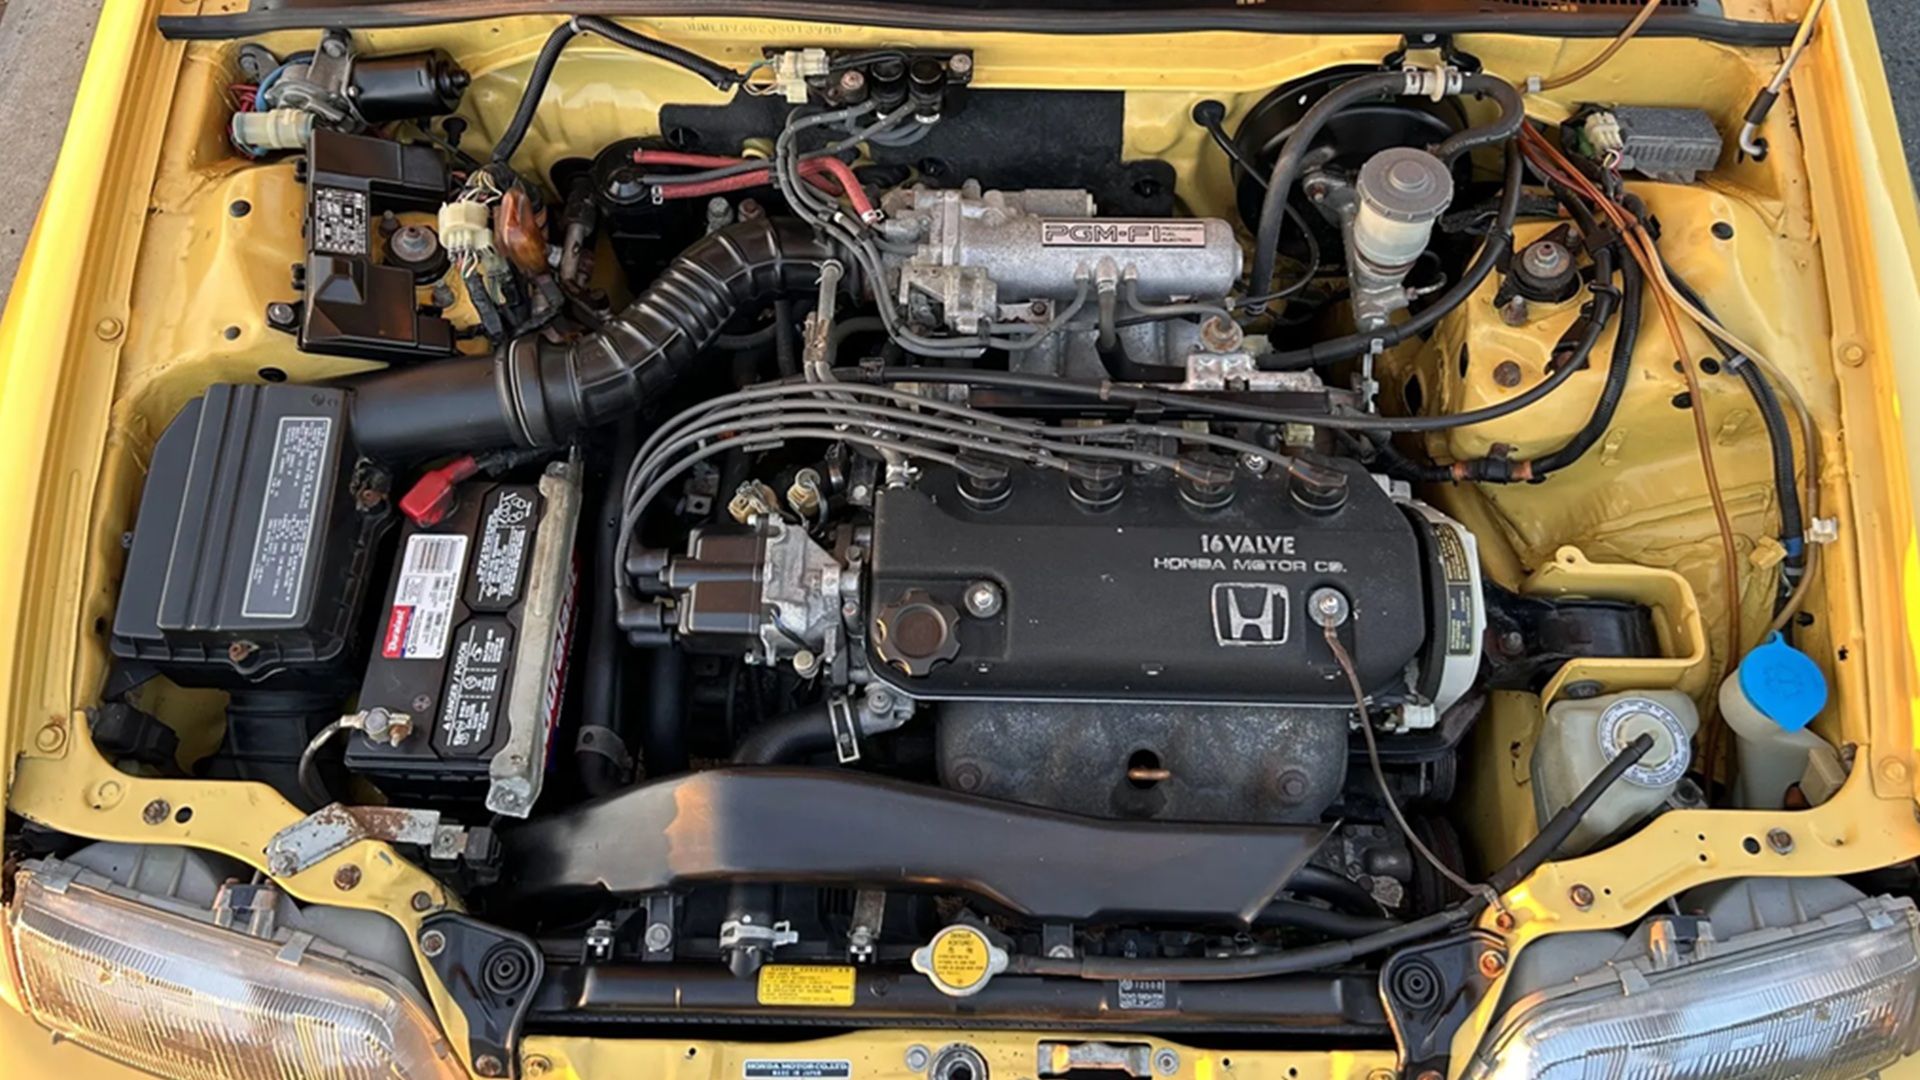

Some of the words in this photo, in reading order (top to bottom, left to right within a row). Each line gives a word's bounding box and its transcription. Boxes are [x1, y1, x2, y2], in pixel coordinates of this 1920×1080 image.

[1201, 534, 1224, 553] 16
[1225, 534, 1296, 555] VALVE
[1153, 557, 1227, 571] HONDA
[1232, 558, 1308, 572] MOTOR
